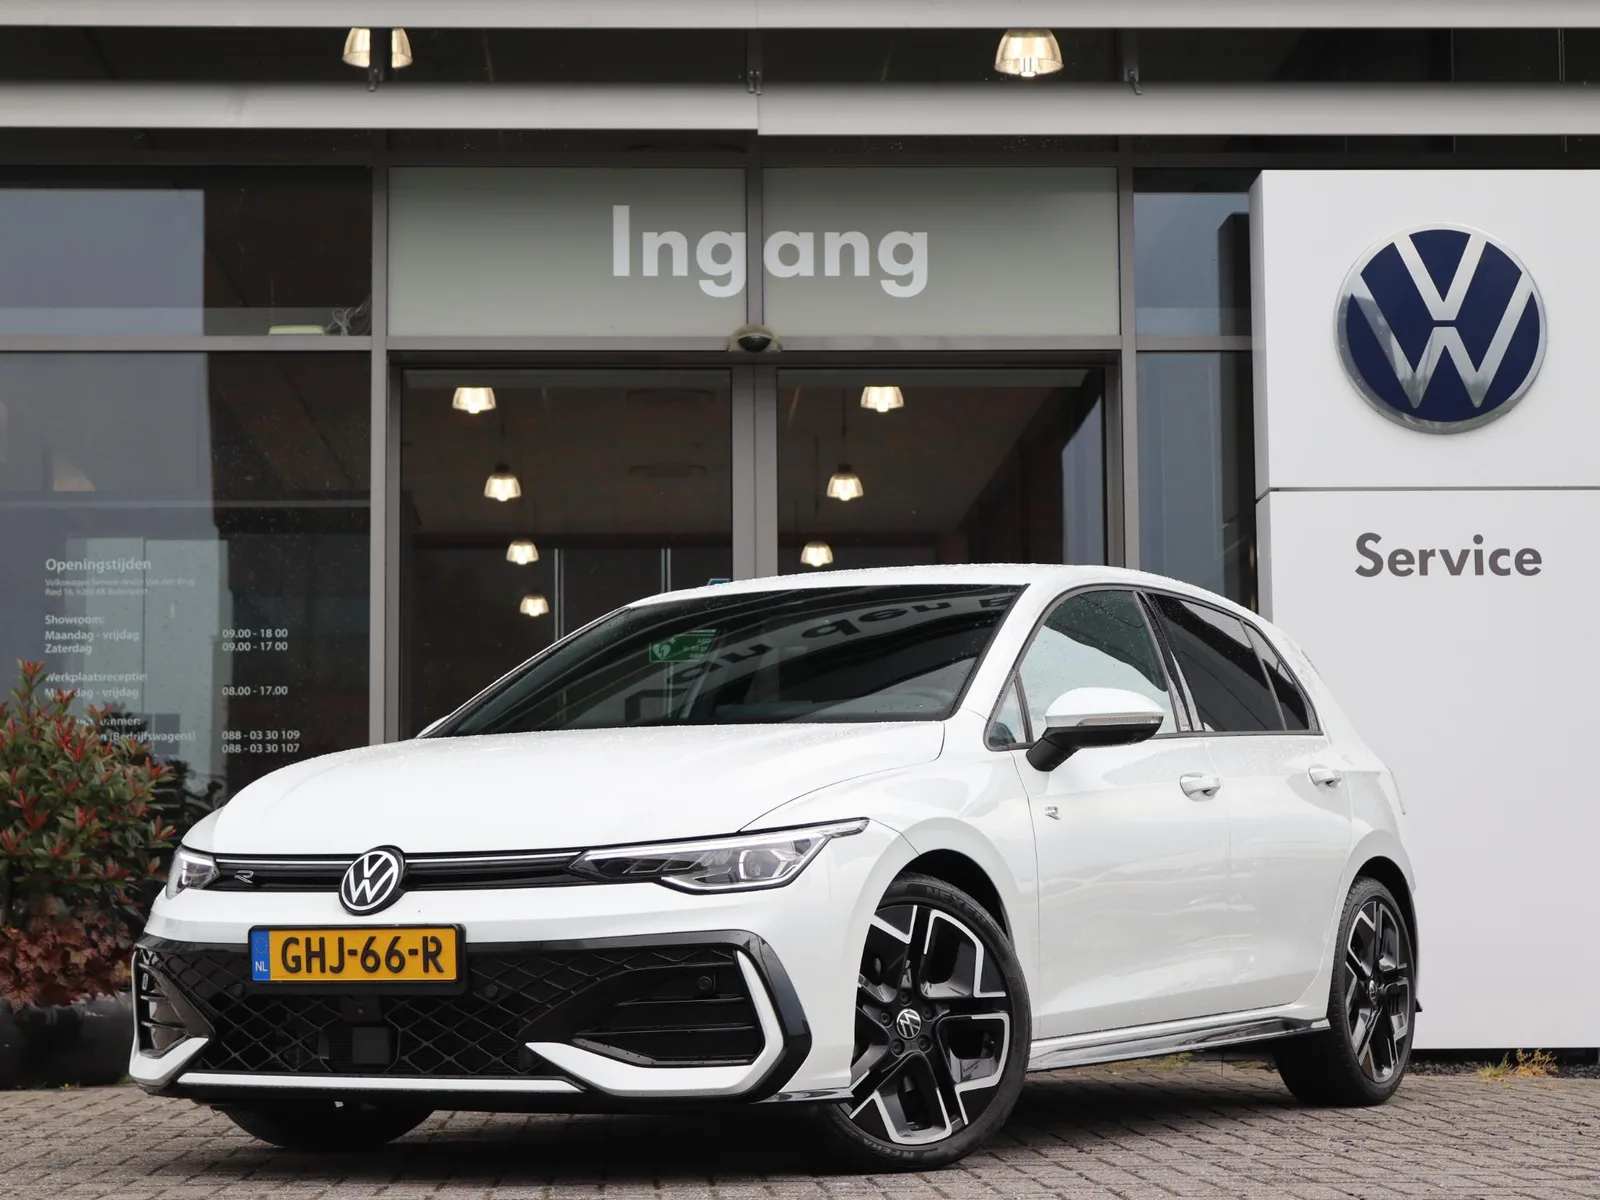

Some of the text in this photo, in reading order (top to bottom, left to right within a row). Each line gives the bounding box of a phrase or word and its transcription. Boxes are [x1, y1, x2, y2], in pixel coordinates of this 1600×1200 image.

[613, 205, 928, 298] Ingang
[1355, 532, 1542, 577] Service
[45, 558, 151, 573] Openingstijden
[45, 614, 104, 625] Showroom:
[45, 630, 94, 641] Maandag
[103, 630, 139, 641] vrijdag
[222, 629, 251, 638] 09.00
[45, 644, 93, 655] Zaterdag
[222, 642, 251, 651] 09.00
[45, 688, 94, 699] Mdag
[103, 688, 139, 699] vrijdag
[222, 686, 251, 695] 08.00
[260, 686, 288, 695] 17.00
[222, 731, 241, 740] 088
[250, 731, 262, 740] 03
[265, 731, 278, 740] 30
[281, 731, 300, 740] 109
[222, 744, 241, 753] 088
[250, 744, 262, 753] 03
[265, 744, 278, 753] 30
[281, 744, 299, 753] 107
[255, 935, 444, 974] NL GHJ-66-R
